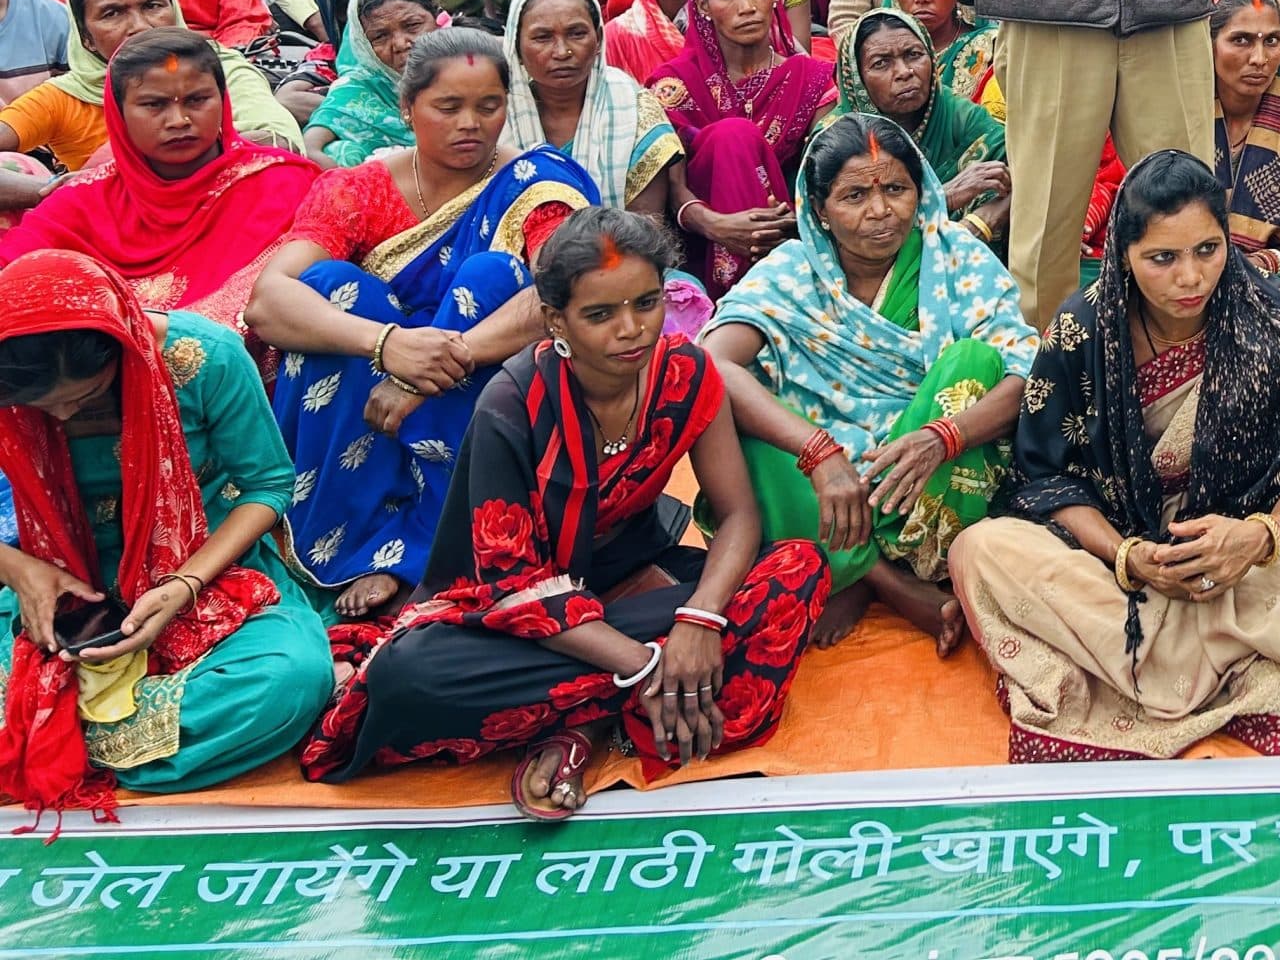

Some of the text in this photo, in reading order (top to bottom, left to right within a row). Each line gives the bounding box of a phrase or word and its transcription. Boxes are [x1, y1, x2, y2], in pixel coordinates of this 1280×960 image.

[31, 851, 184, 909] जेल
[197, 842, 417, 906] जायेंगे
[430, 853, 522, 898] या
[535, 829, 714, 895] लाठी
[732, 821, 901, 885] गोली
[1168, 821, 1257, 865] पर
